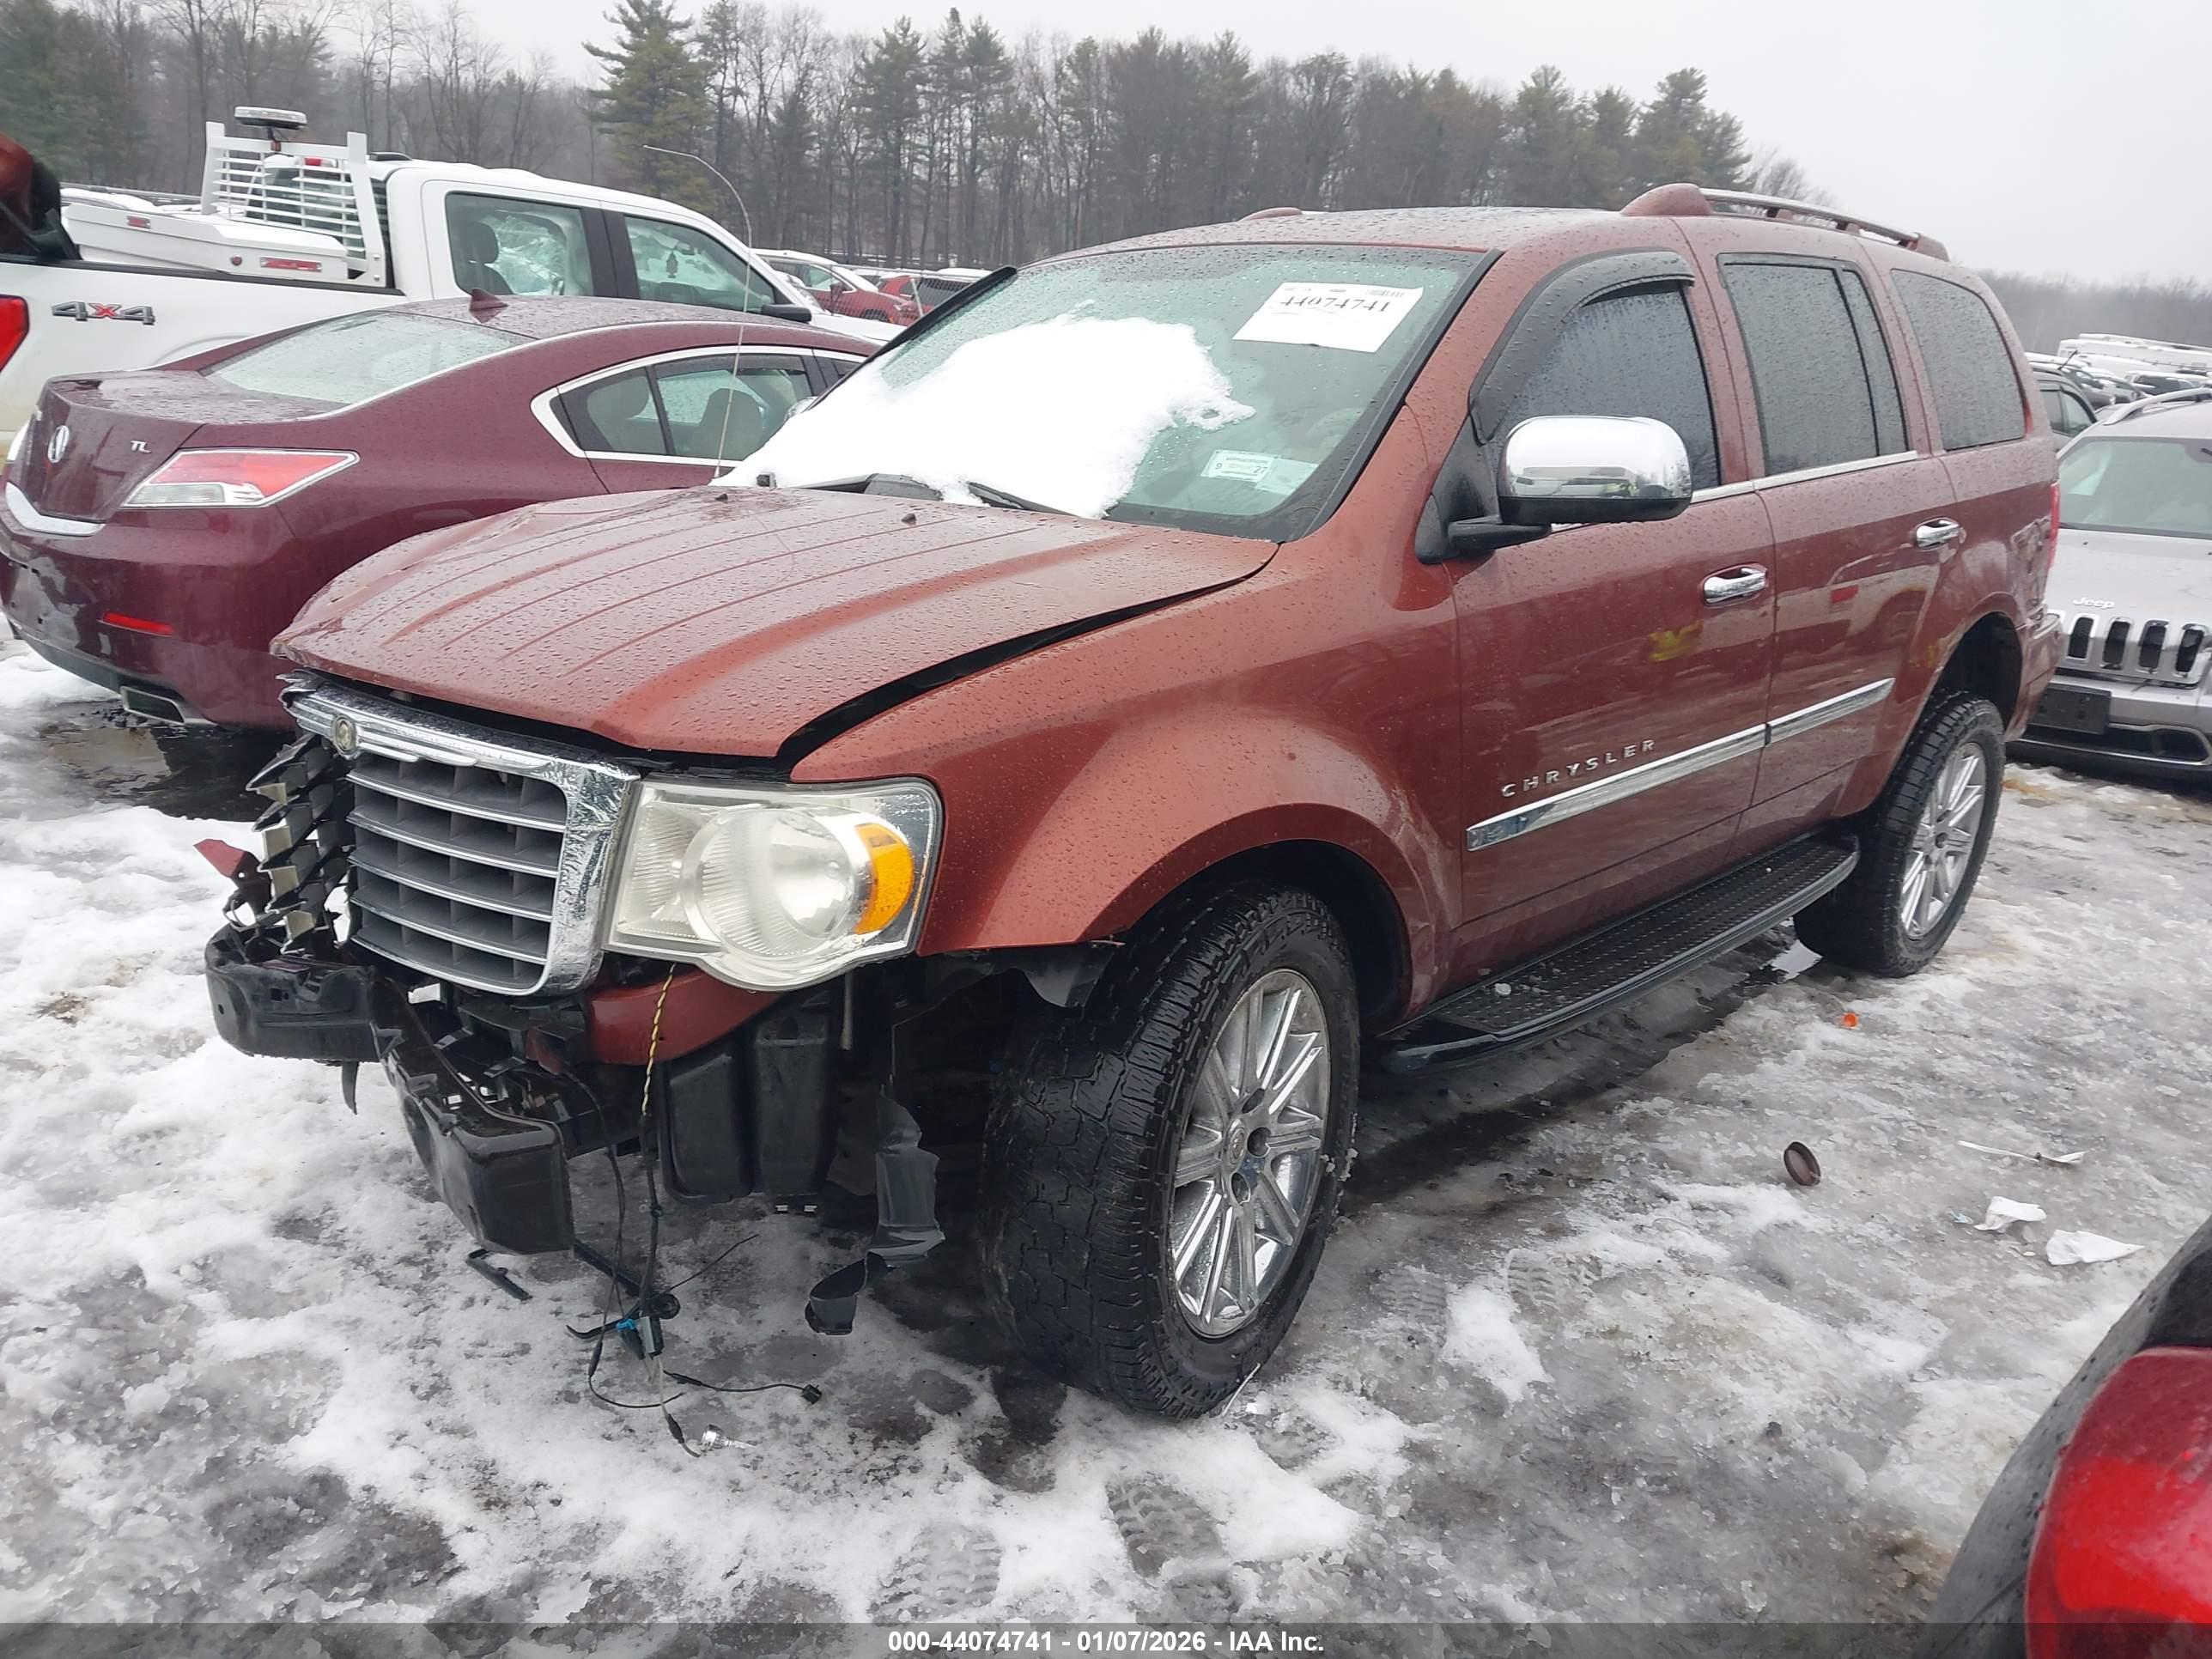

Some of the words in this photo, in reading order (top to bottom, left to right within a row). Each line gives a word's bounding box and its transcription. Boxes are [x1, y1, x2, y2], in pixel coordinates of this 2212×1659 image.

[1279, 295, 1390, 313] 44074741
[130, 440, 152, 453] TL
[2072, 596, 2116, 610] Jeep
[1500, 739, 1656, 799] CHRYSLER
